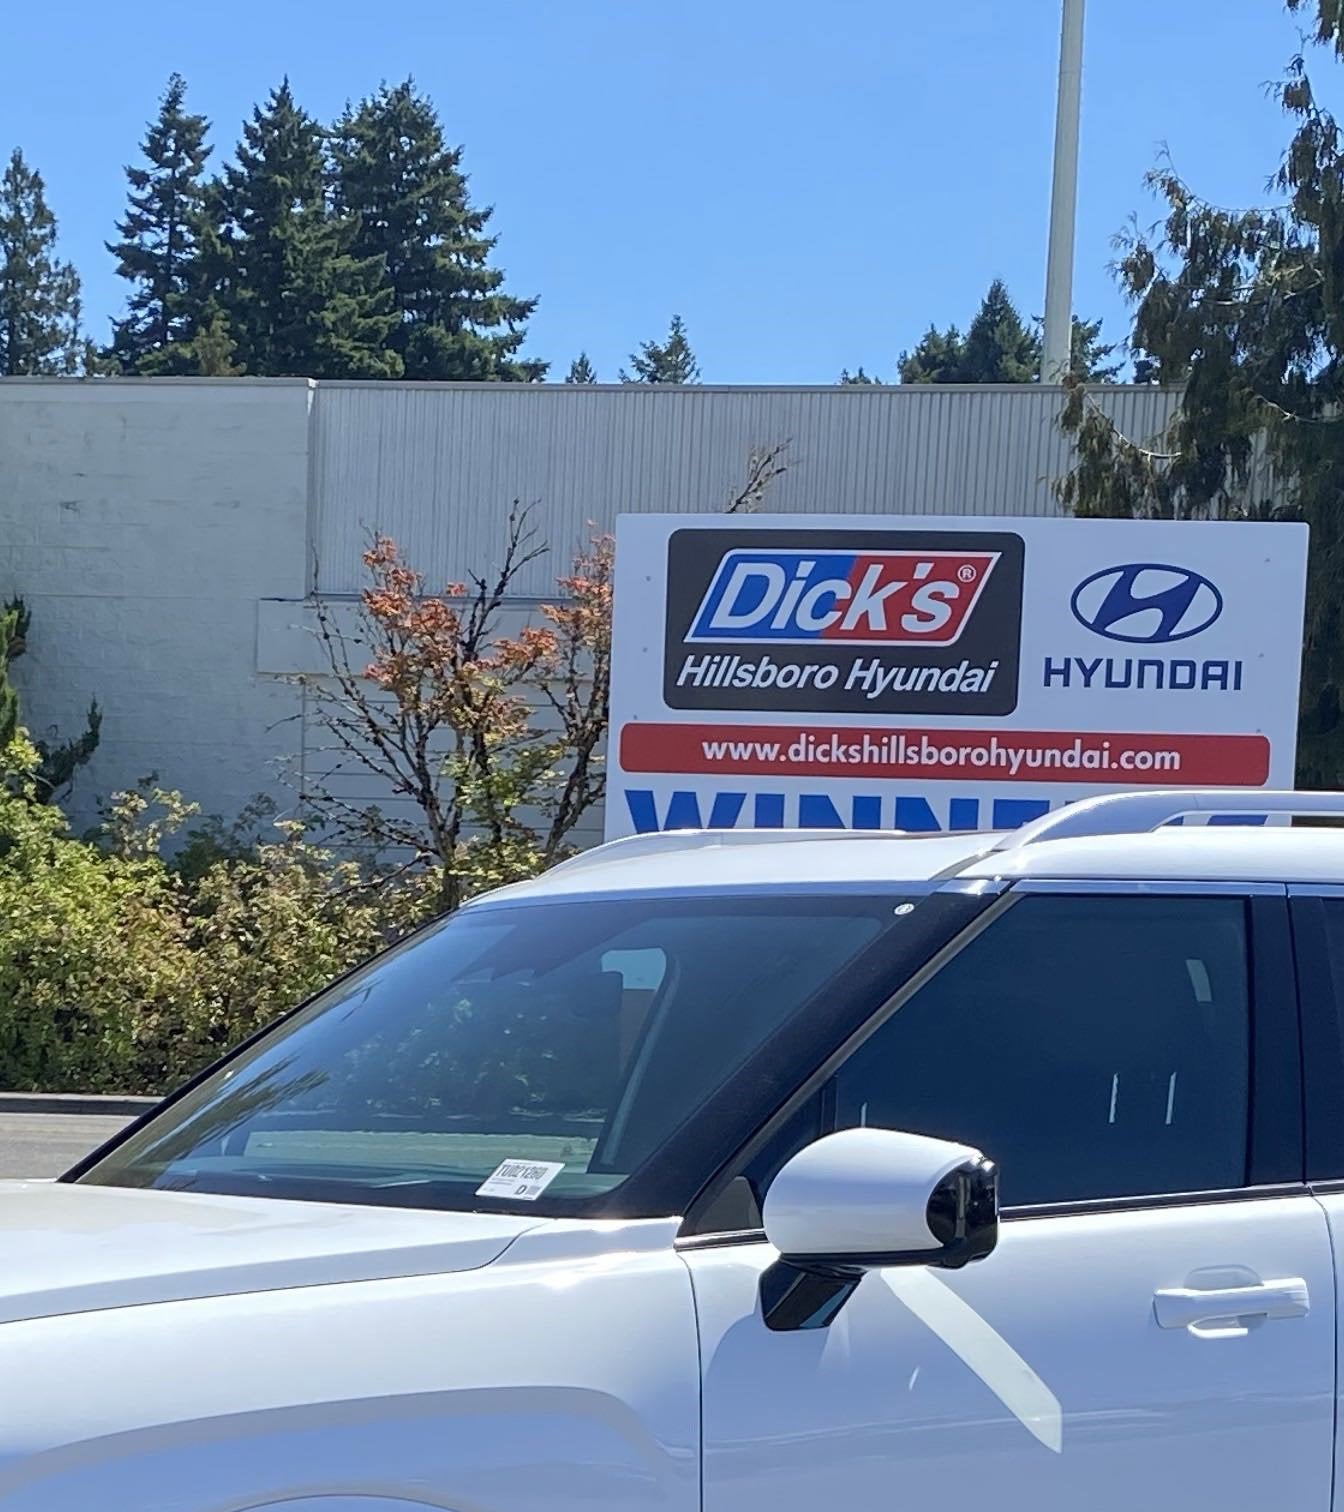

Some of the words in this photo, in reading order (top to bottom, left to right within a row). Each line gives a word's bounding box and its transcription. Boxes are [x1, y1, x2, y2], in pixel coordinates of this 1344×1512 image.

[709, 561, 960, 633] Dick's
[676, 655, 839, 689] Hillsboro
[844, 658, 999, 699] Hyundai
[1043, 656, 1243, 691] HYUNDAI
[701, 733, 1181, 775] www.dickshillsborohyundai.com
